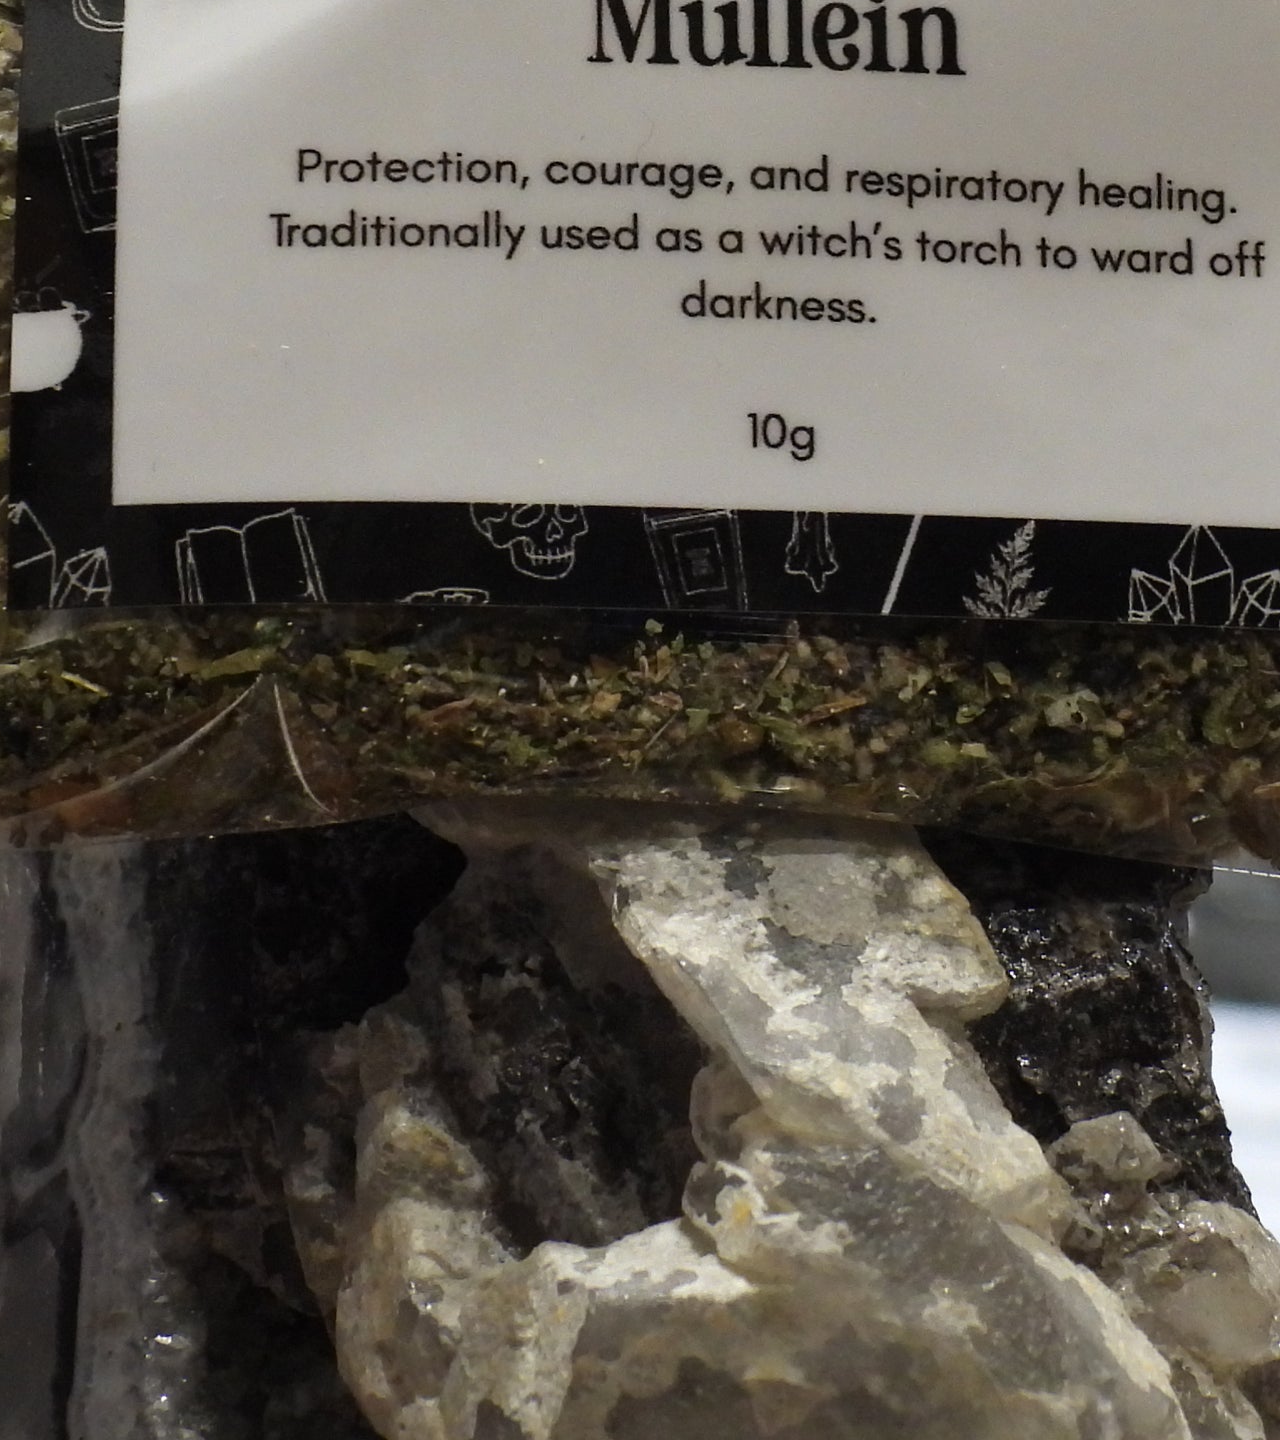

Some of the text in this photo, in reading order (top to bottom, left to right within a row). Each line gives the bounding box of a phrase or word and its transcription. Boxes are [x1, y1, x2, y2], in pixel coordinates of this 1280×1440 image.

[297, 149, 1239, 225] Protection, courage, and respiratory healing.
[269, 210, 527, 262] Traditionally
[541, 213, 641, 253] used
[656, 228, 705, 255] as
[718, 230, 745, 256] a
[916, 229, 1023, 269] torch
[1036, 237, 1079, 271] to
[1091, 238, 1195, 277] ward
[1209, 240, 1268, 280] off
[681, 280, 879, 325] darkness.
[747, 413, 817, 464] 10g
